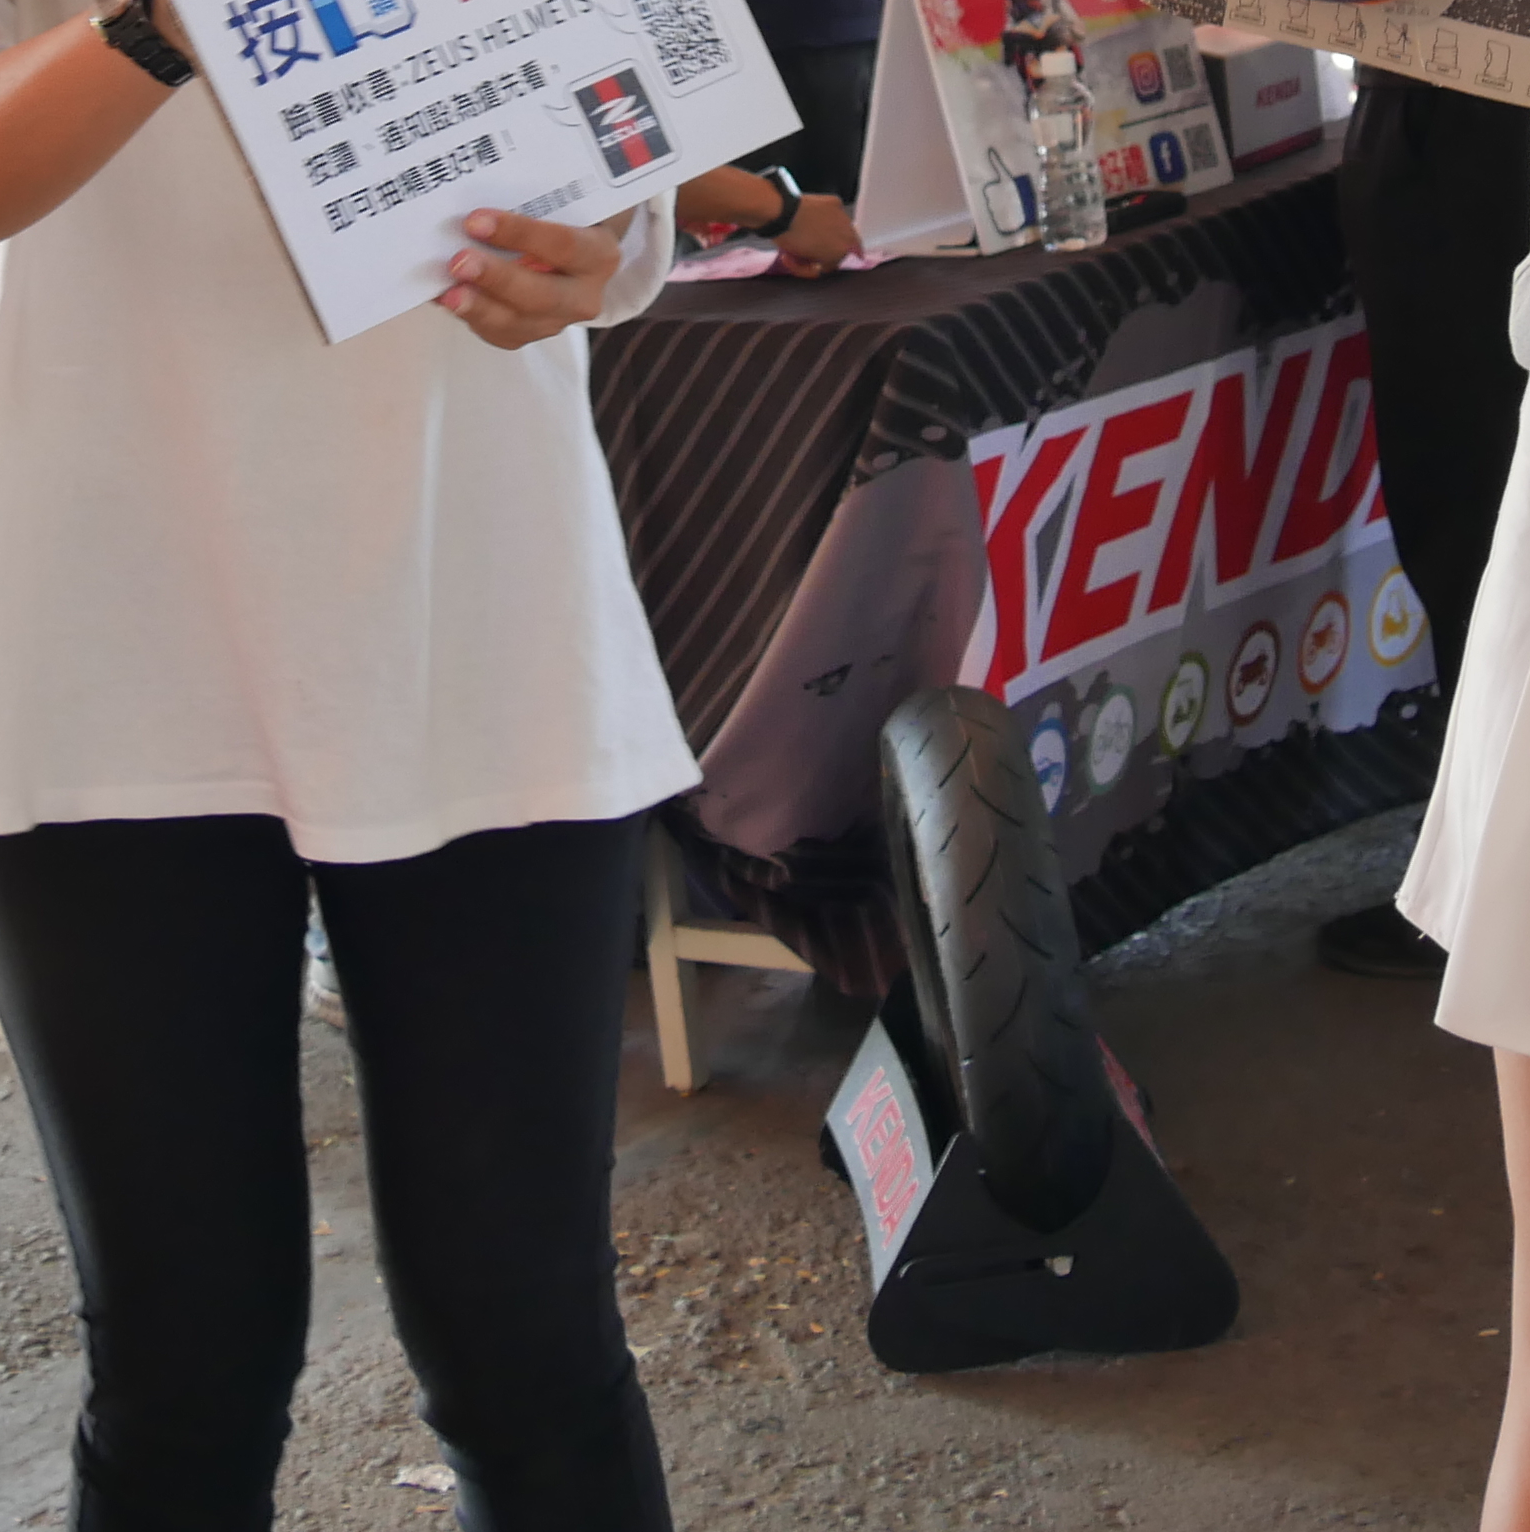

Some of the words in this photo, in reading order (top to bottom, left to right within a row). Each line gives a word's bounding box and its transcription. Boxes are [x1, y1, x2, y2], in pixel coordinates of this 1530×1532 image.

[596, 115, 658, 148] ZEUS
[972, 330, 1389, 706] KEND
[845, 1065, 921, 1252] KENDA
